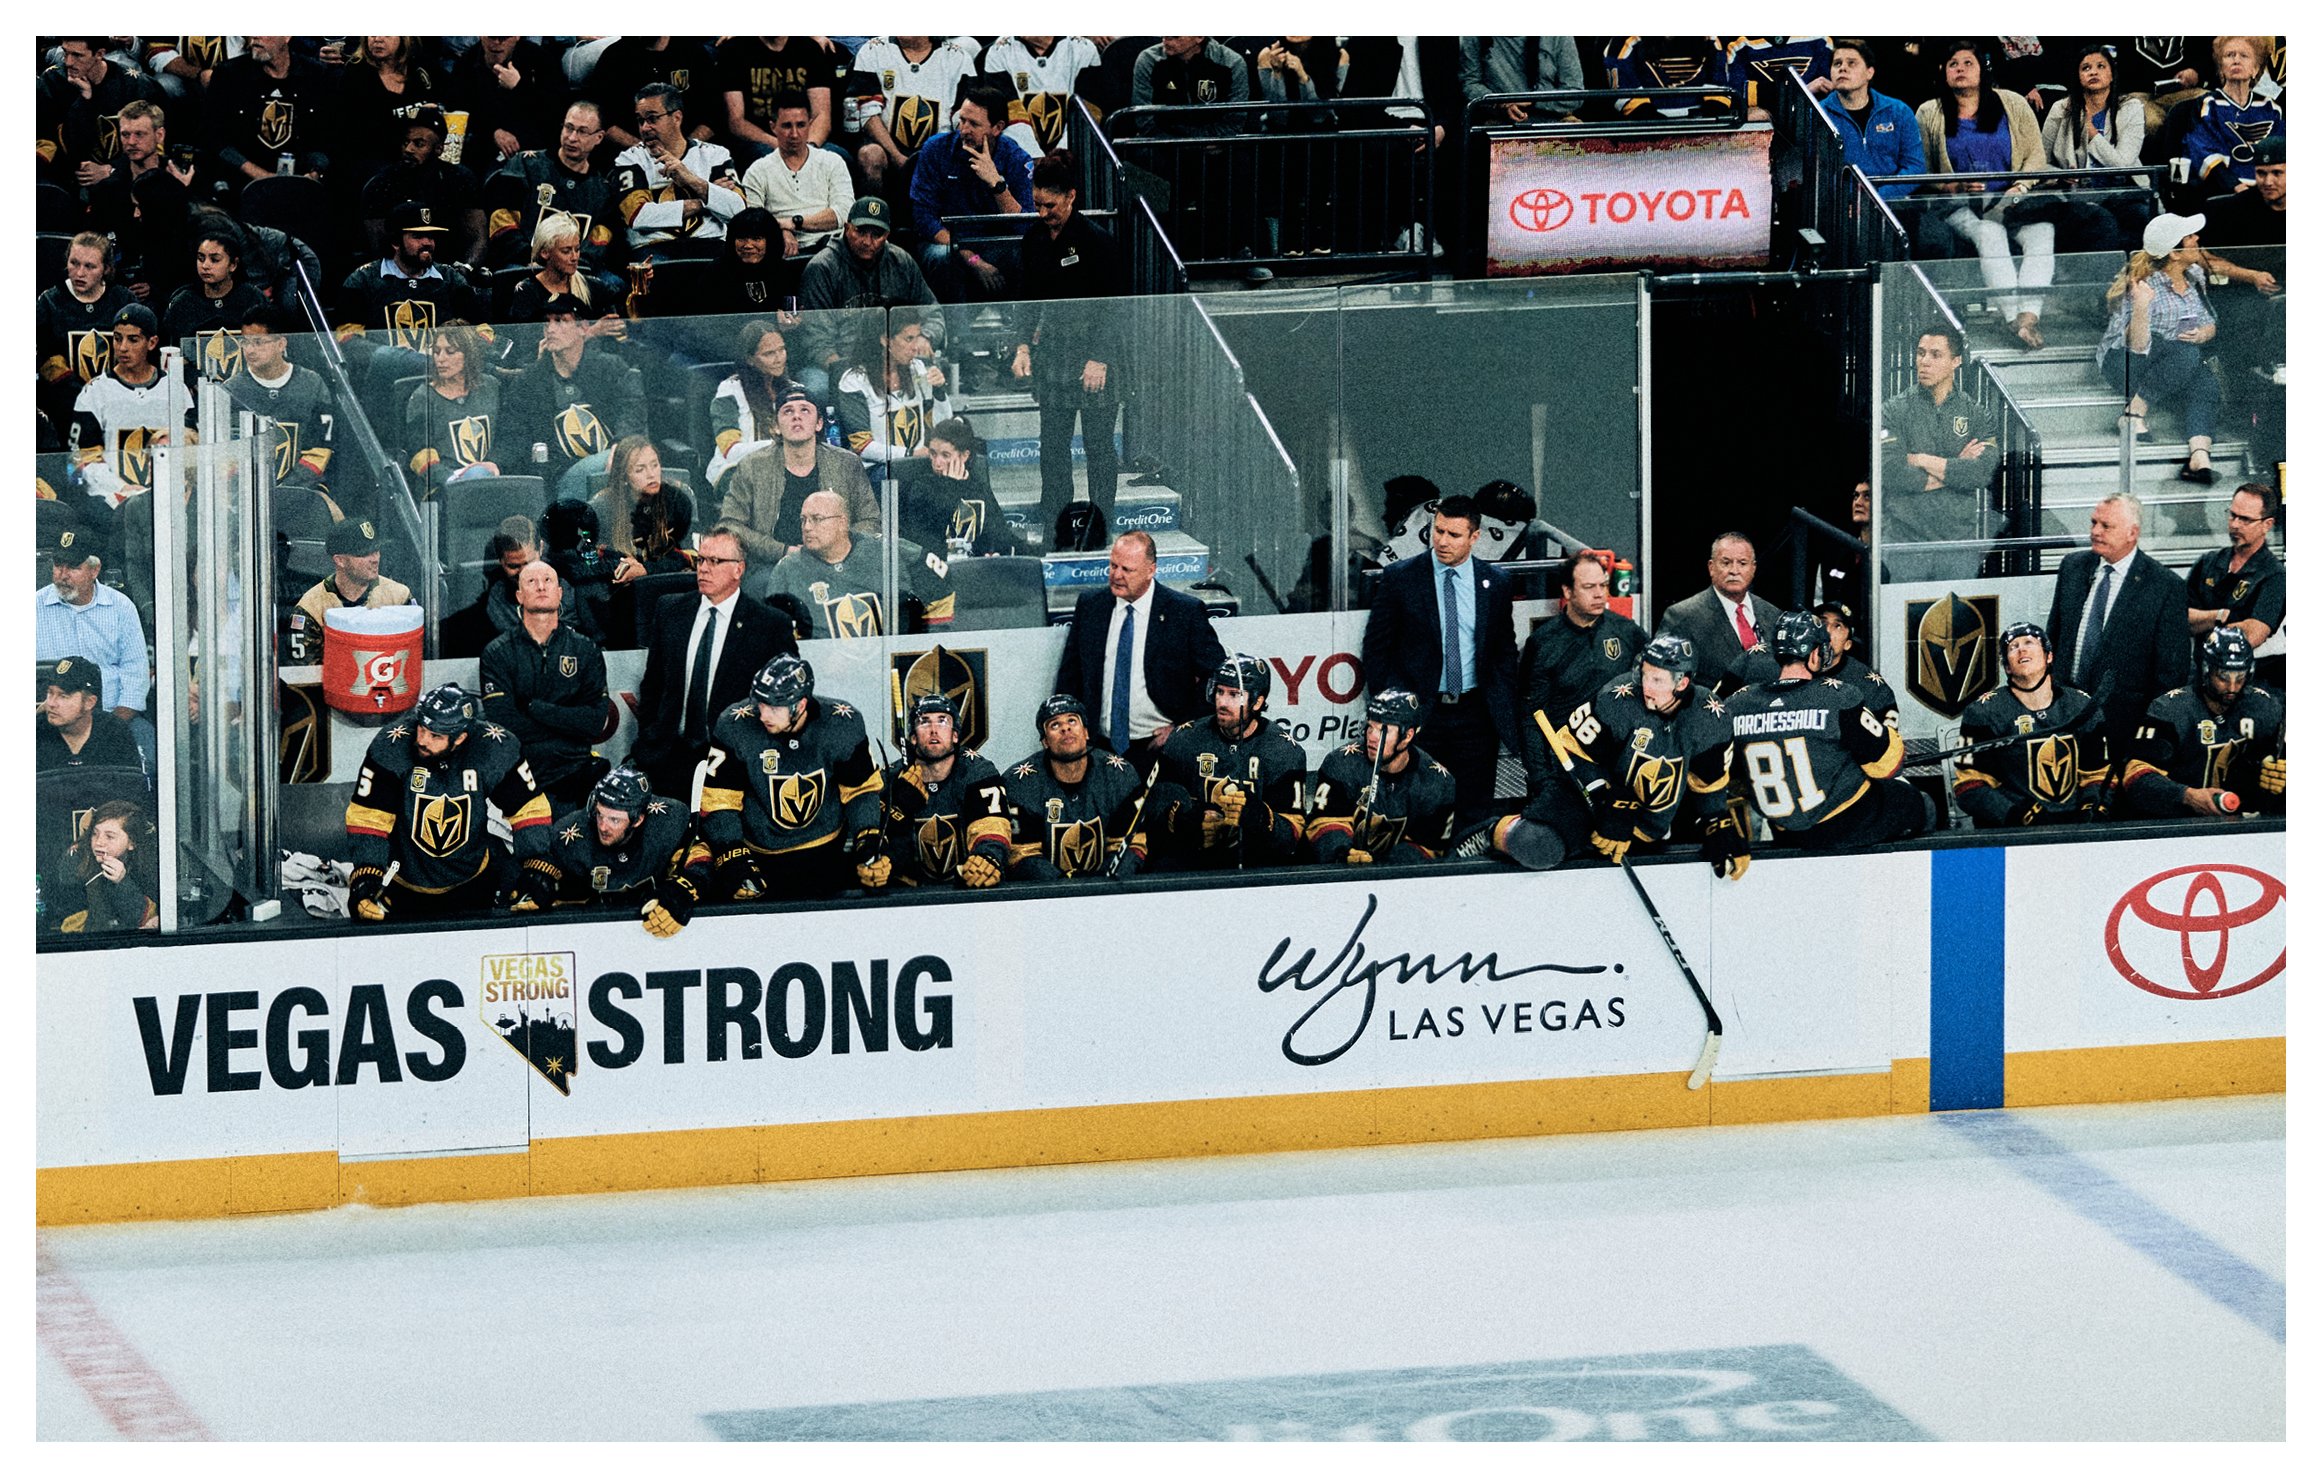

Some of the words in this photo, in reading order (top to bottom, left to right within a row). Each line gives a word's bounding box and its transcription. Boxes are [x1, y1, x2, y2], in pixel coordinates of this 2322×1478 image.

[618, 169, 635, 192] 3
[1579, 187, 1751, 225] TOYOTA
[320, 414, 334, 442] 7
[1116, 512, 1174, 526] CreditOne
[291, 633, 306, 659] 5
[370, 655, 395, 682] G
[1568, 701, 1602, 745] 56
[462, 768, 478, 792] A
[516, 759, 537, 792] 5
[1249, 756, 1260, 779] A
[1744, 736, 1826, 819] 81
[357, 766, 375, 798] 5
[1314, 782, 1332, 811] 4
[1651, 915, 1691, 970] CCM
[489, 956, 564, 981] VEGAS
[485, 977, 570, 1003] STRONG
[132, 979, 467, 1096] VEGAS
[586, 955, 953, 1069] STRONG
[1389, 1006, 1464, 1041] LAS
[1482, 997, 1626, 1034] VEGAS
